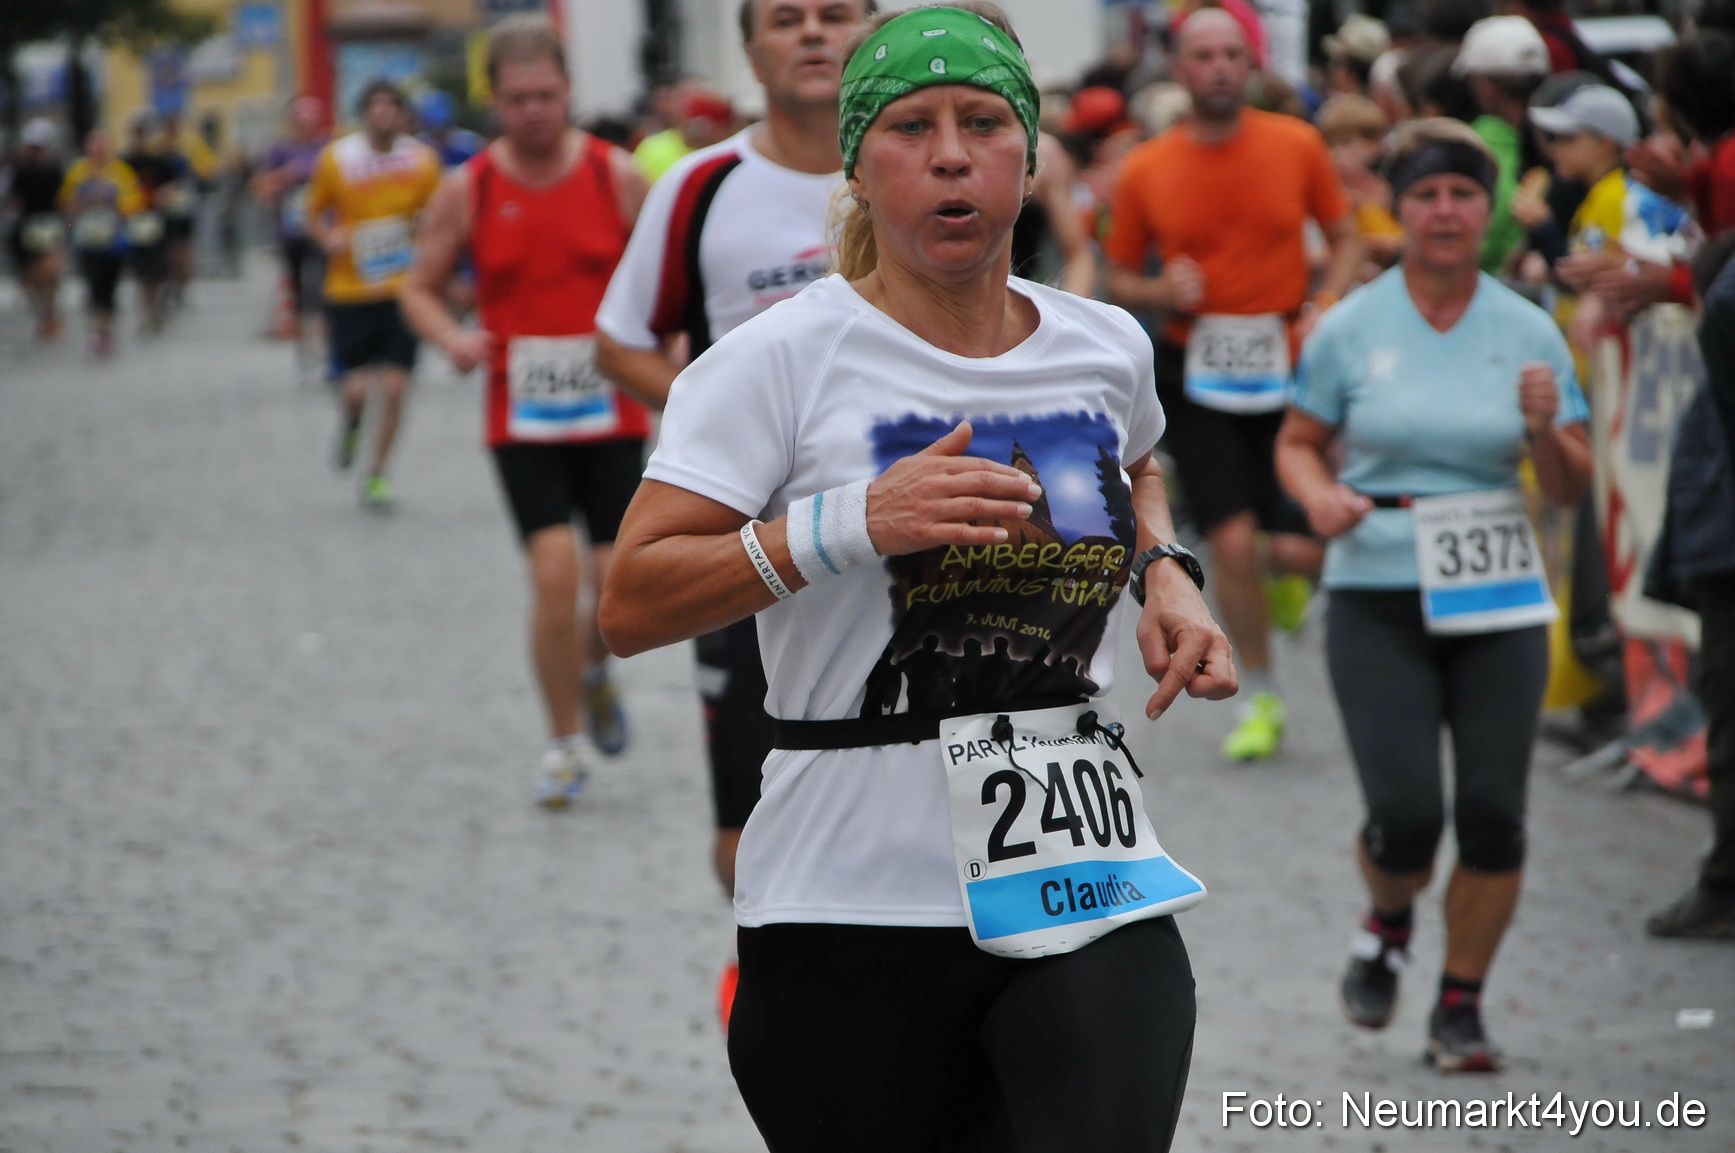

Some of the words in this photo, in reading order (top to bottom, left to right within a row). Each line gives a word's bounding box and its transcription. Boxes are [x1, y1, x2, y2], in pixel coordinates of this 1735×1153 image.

[747, 540, 786, 596] ENTERTAIN
[940, 542, 1126, 571] AMBERGER
[1019, 623, 1051, 641] 2014
[981, 758, 1137, 864] 2406
[970, 863, 981, 878] D
[1040, 874, 1147, 917] Claudia
